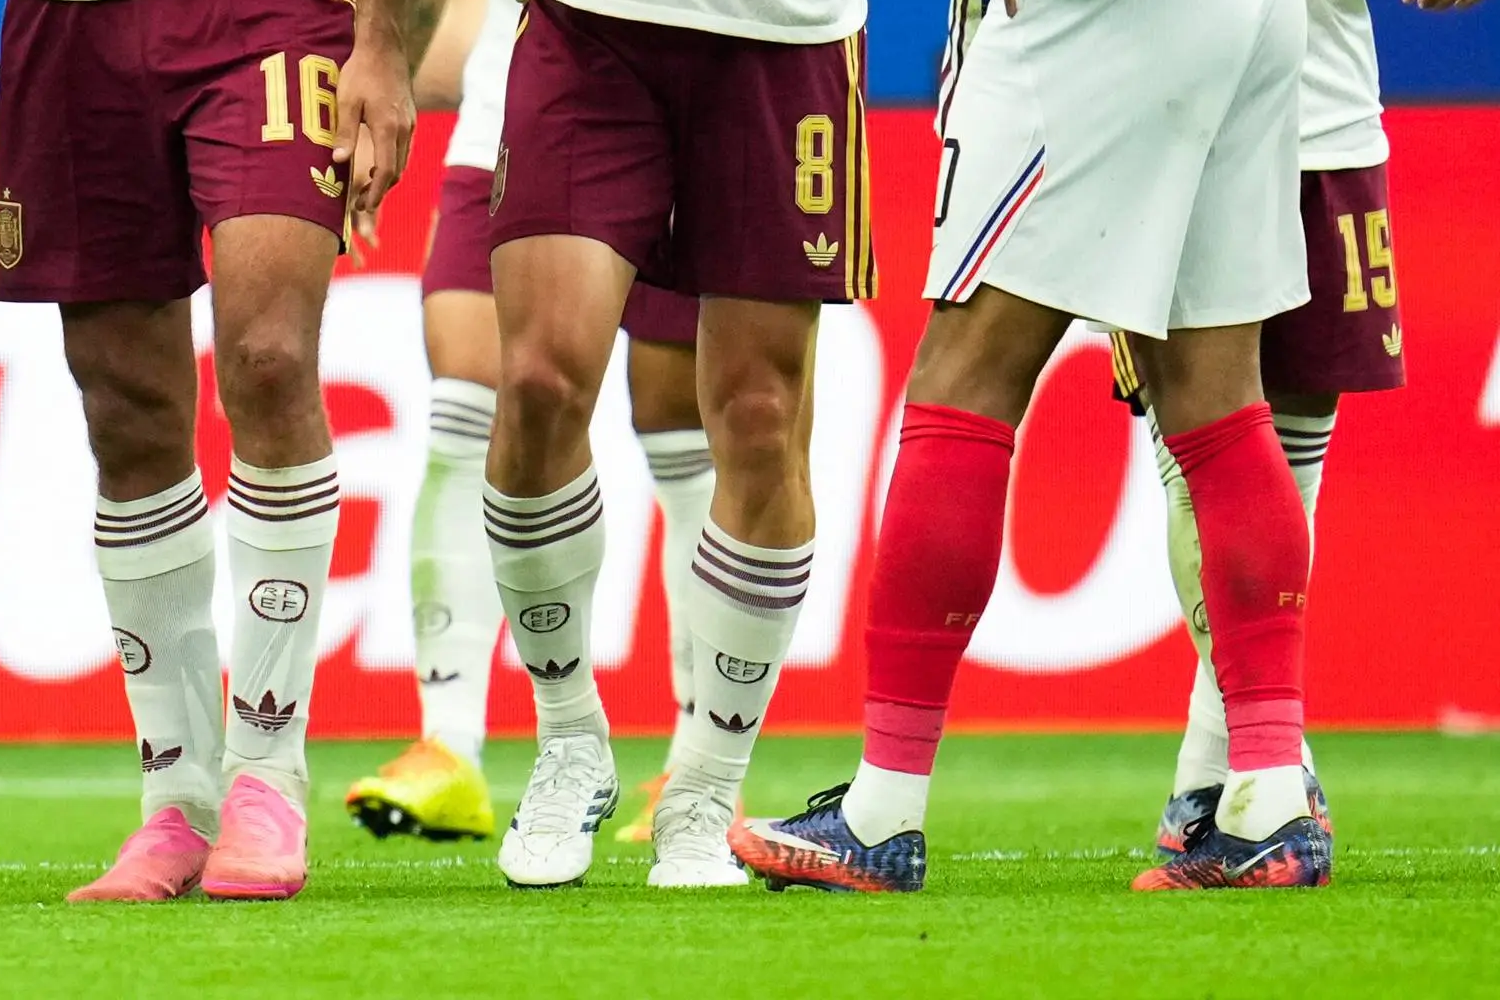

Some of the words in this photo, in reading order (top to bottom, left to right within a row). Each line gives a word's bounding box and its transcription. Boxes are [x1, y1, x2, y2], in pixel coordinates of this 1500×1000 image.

[259, 51, 341, 148] 16
[795, 114, 834, 215] 8
[1337, 208, 1396, 313] 15
